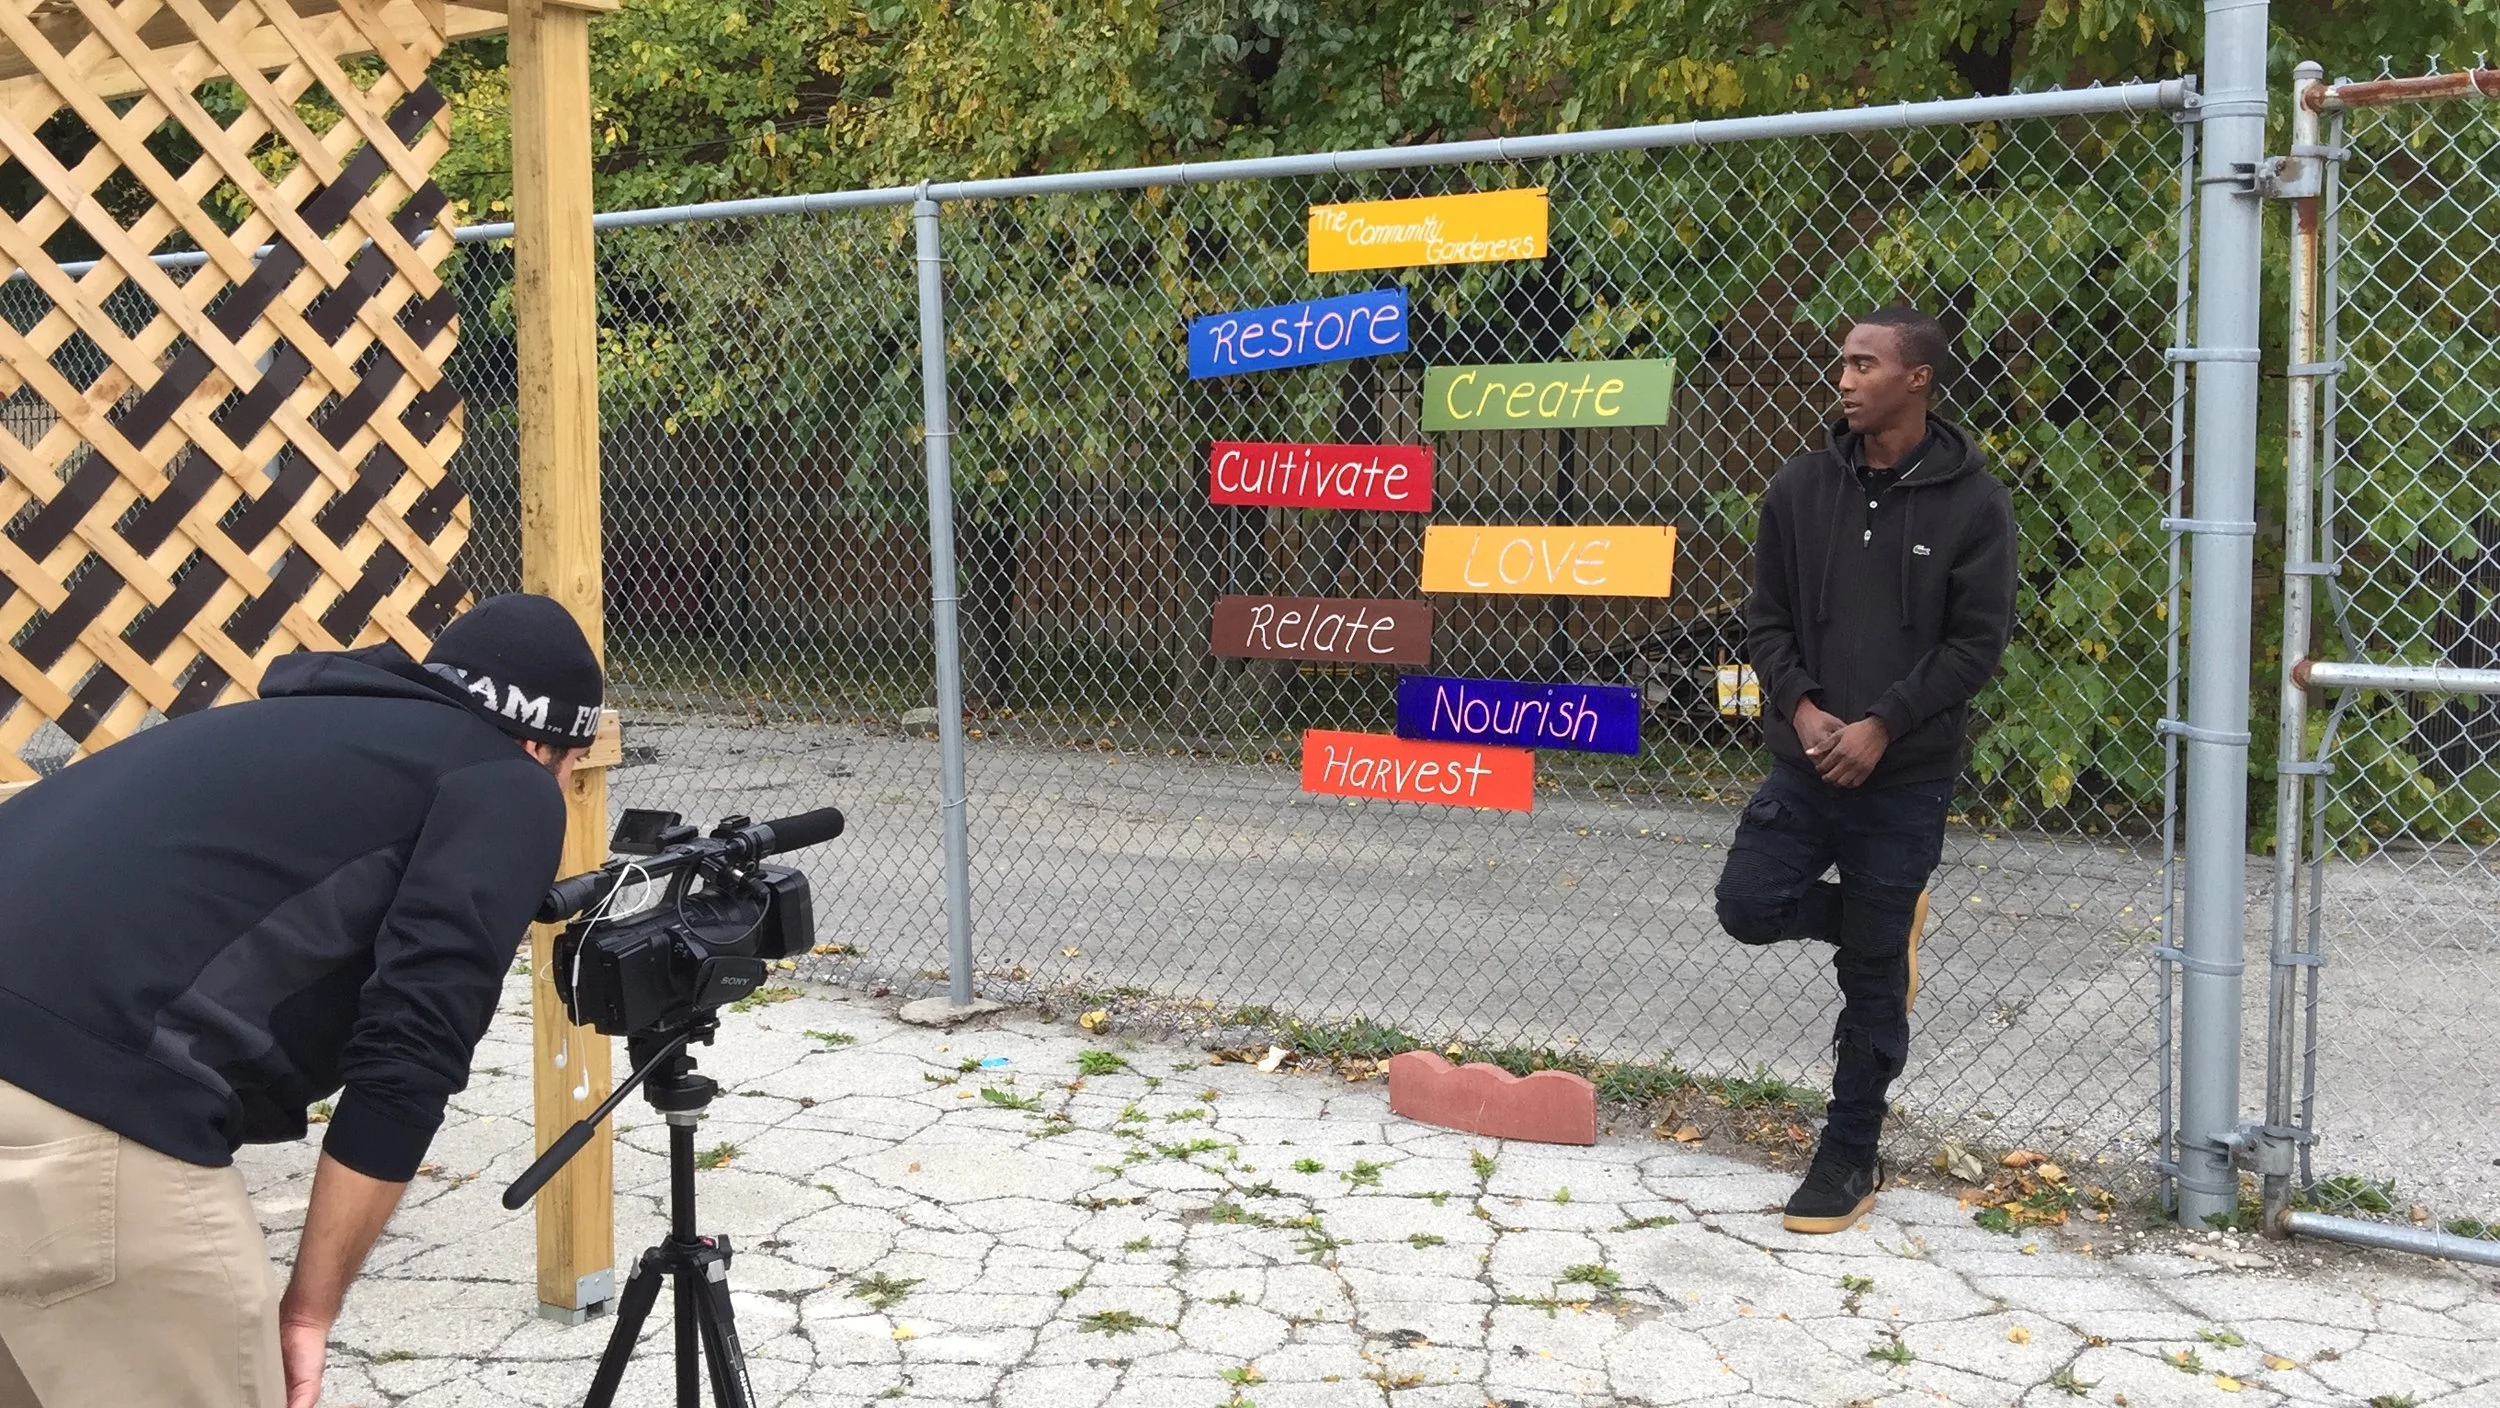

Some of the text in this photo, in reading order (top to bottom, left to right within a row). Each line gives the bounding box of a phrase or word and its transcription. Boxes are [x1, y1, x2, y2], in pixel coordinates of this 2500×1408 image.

[1314, 208, 1444, 245] The Community
[1208, 304, 1401, 365] Restore
[1446, 371, 1624, 420] Create
[1217, 449, 1409, 500] Cultivate
[1464, 533, 1610, 587] LOVE
[1246, 604, 1395, 654] Relate
[457, 668, 550, 730] AM
[569, 705, 600, 737] FO
[1431, 685, 1598, 742] Nourish
[1323, 745, 1493, 797] Harvest
[720, 976, 750, 986] SONY
